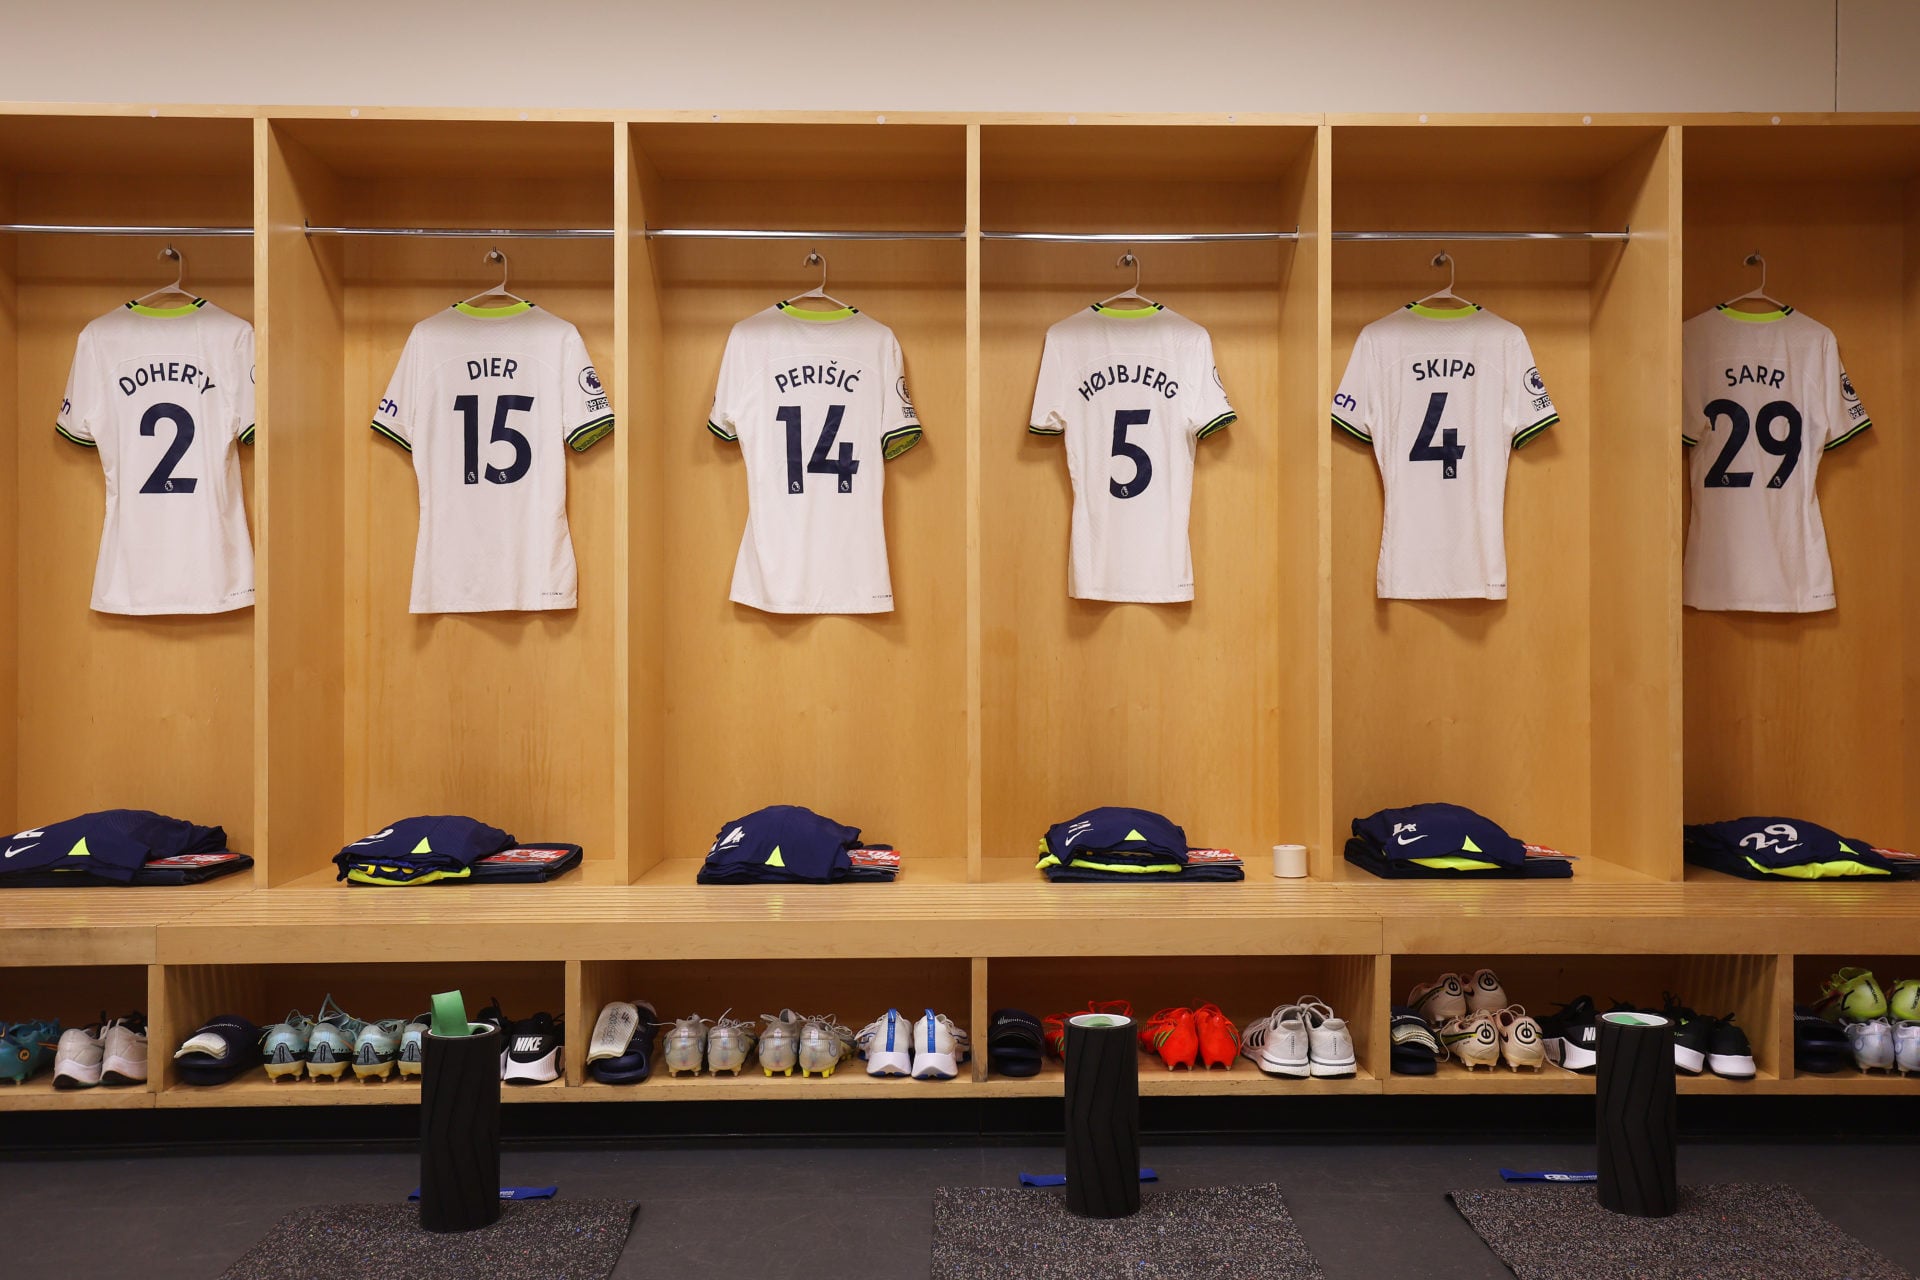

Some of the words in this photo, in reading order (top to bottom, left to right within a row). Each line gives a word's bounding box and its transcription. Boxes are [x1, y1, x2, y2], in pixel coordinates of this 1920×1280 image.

[118, 362, 216, 397] DOHERY
[467, 357, 518, 381] DIER
[774, 360, 862, 393] PERIŠIĆ
[1078, 364, 1179, 402] HØJBJERG
[1412, 358, 1476, 381] SKIPP
[1724, 364, 1786, 390] SARR
[1333, 393, 1357, 412] ch
[138, 402, 198, 494] 2
[453, 394, 535, 485] 15
[775, 404, 860, 495] 14
[1408, 392, 1466, 480] 4
[1703, 398, 1803, 489] 29
[1109, 409, 1153, 500] 5
[1739, 824, 1787, 851] 29
[513, 1036, 543, 1052] NIKE
